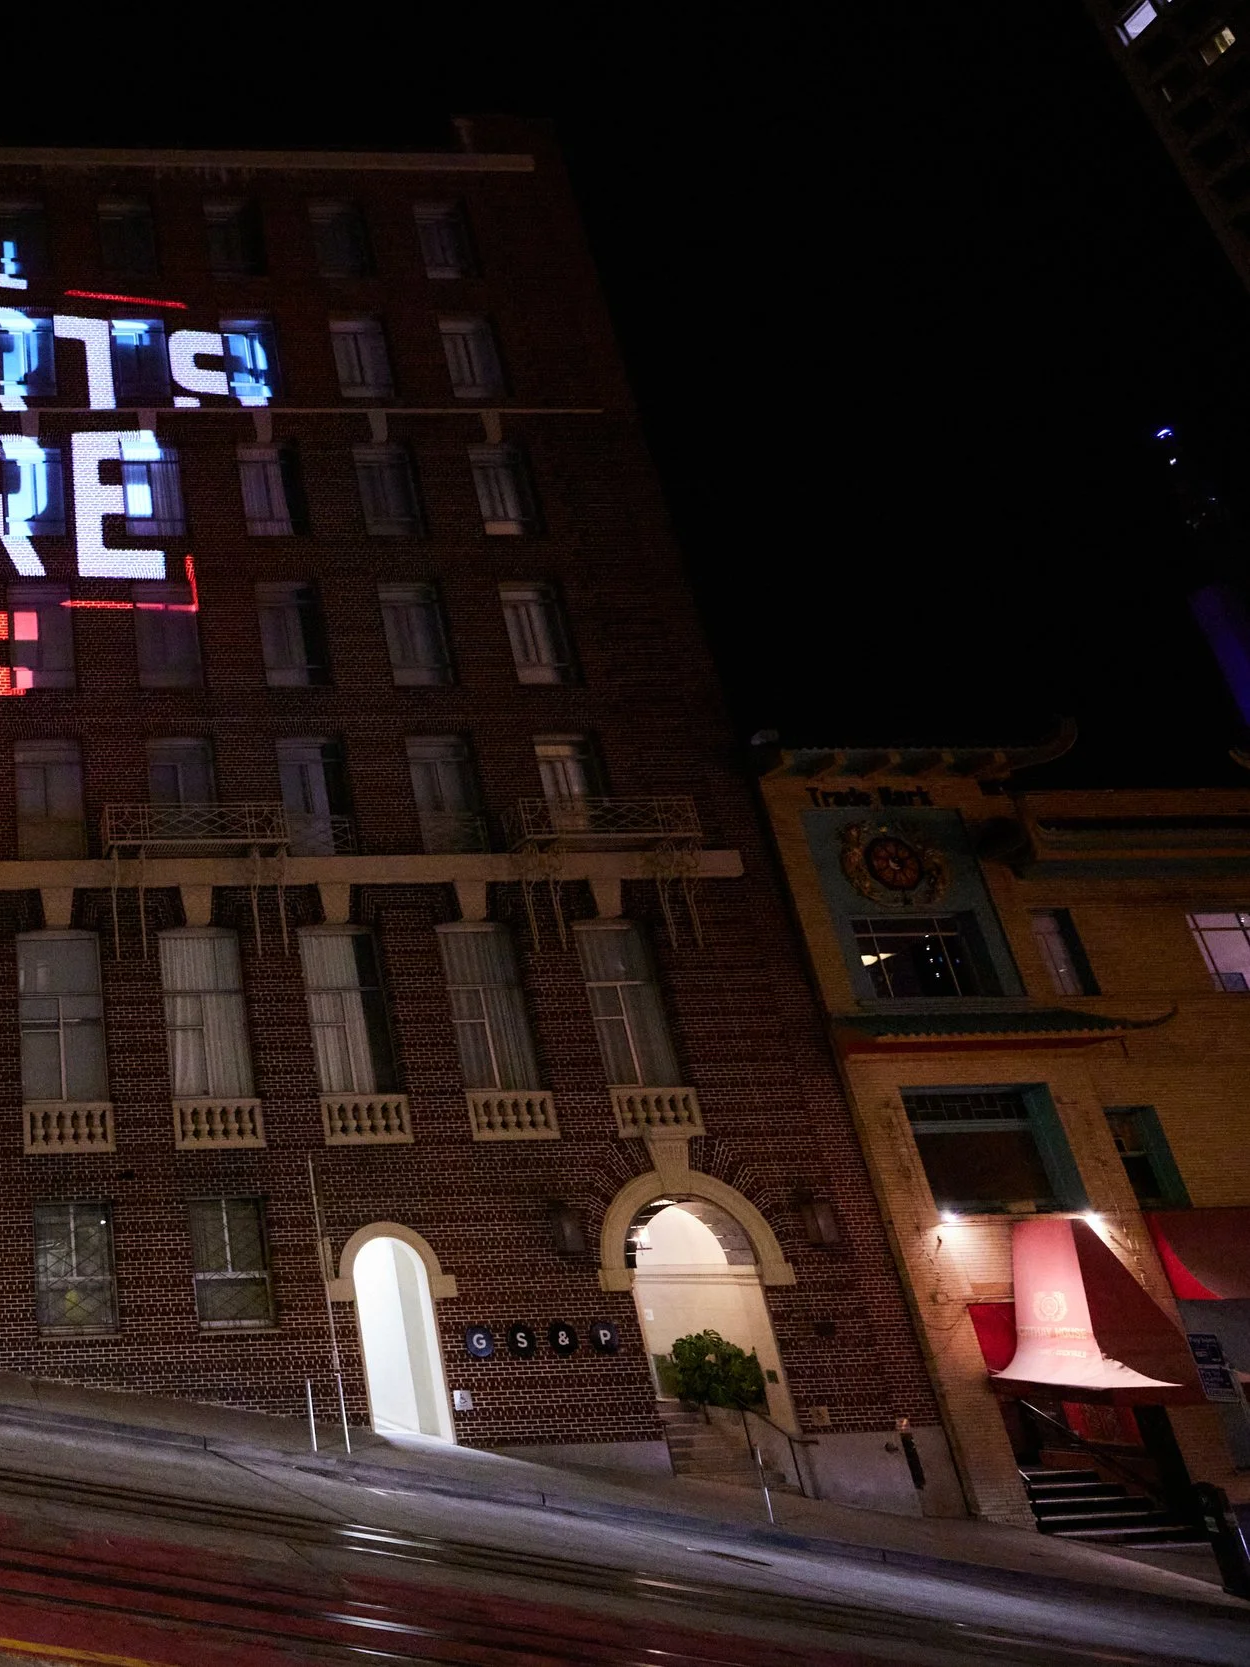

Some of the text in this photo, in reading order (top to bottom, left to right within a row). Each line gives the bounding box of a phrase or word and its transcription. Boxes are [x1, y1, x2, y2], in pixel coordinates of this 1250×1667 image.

[805, 786, 934, 807] Trade Mark
[1054, 1327, 1087, 1340] HOUSE
